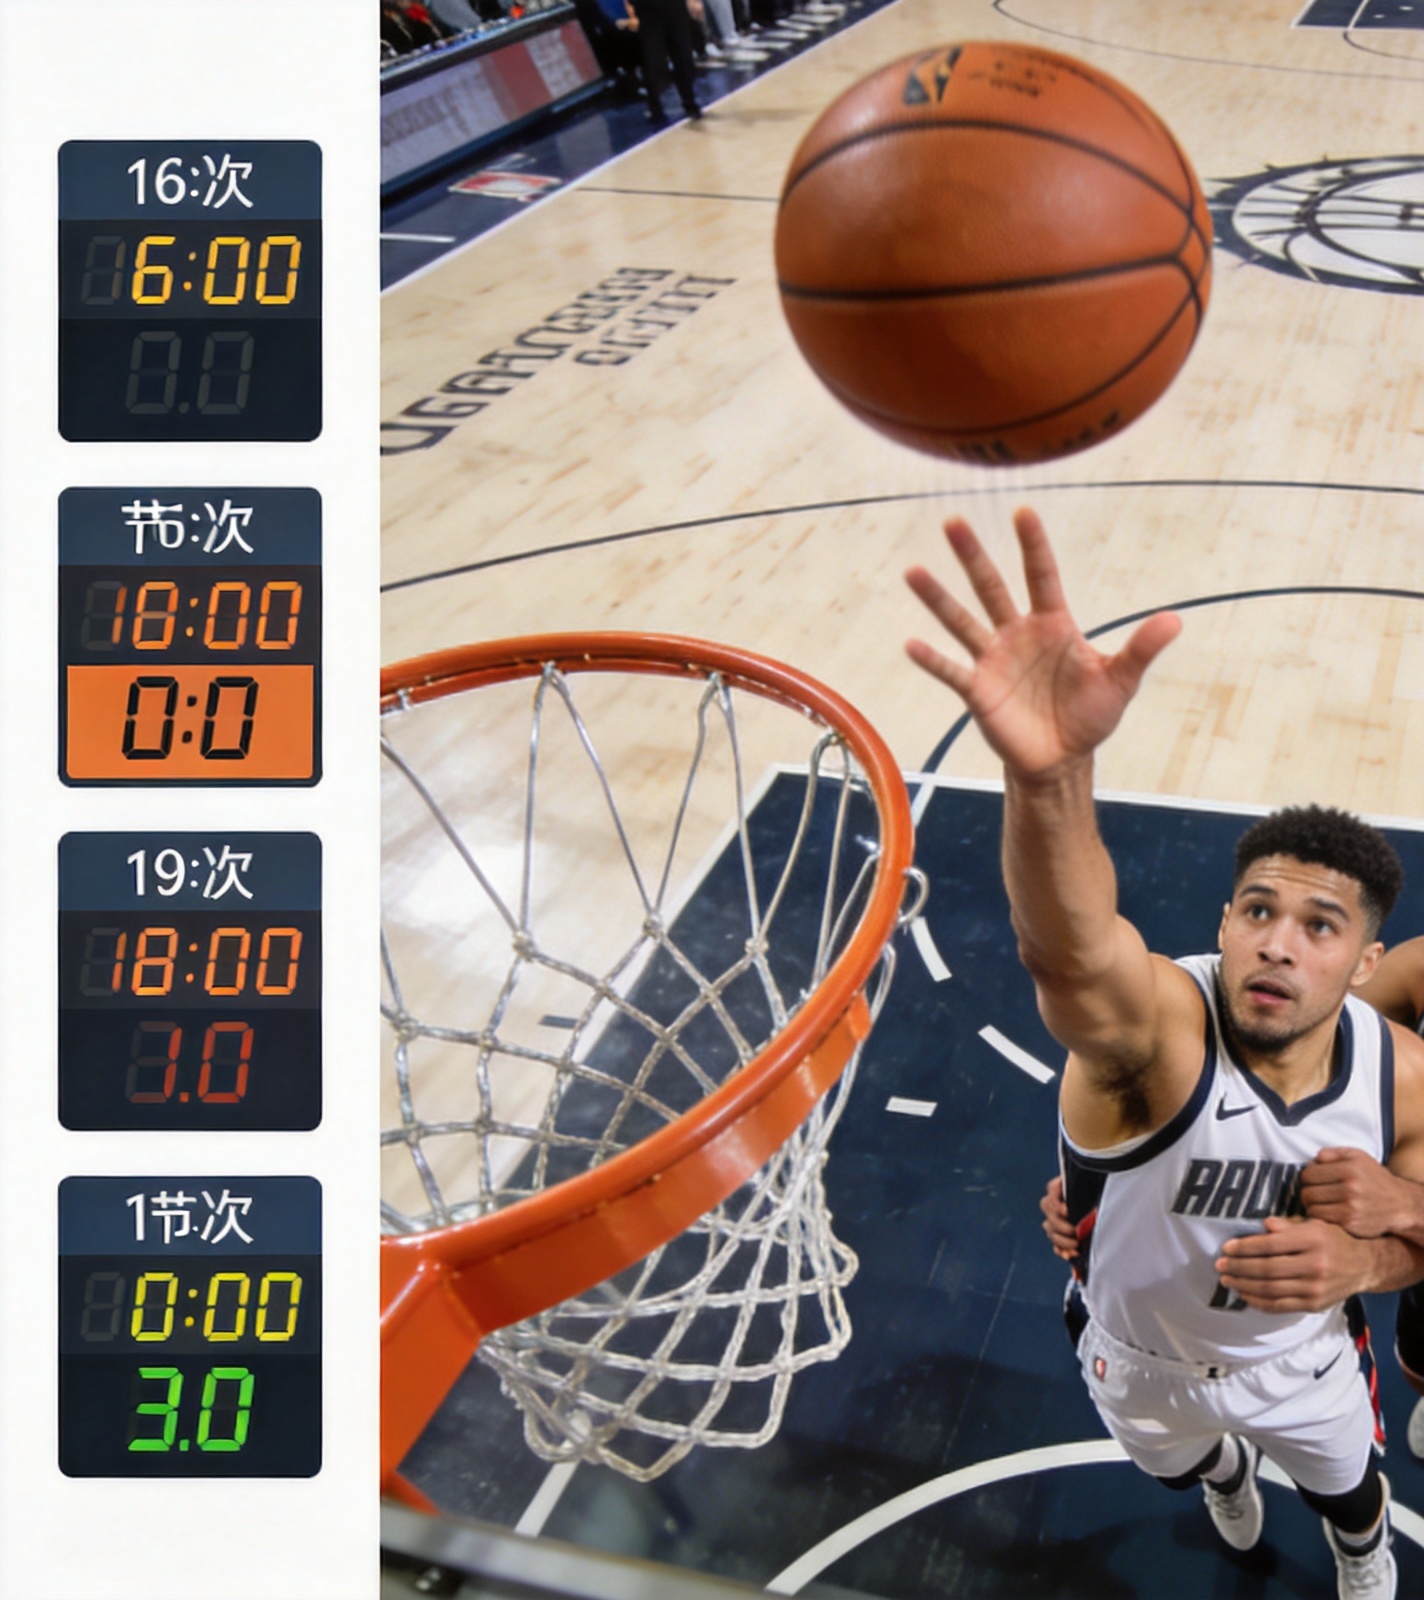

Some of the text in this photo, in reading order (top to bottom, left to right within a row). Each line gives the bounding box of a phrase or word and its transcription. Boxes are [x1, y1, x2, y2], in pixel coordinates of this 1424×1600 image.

[126, 153, 255, 209] 16:次
[121, 676, 259, 760] 0:0
[126, 845, 255, 901] 19:次
[111, 926, 303, 996] 18:00
[130, 1271, 303, 1343] 0:00
[128, 1366, 255, 1452] 3.0
